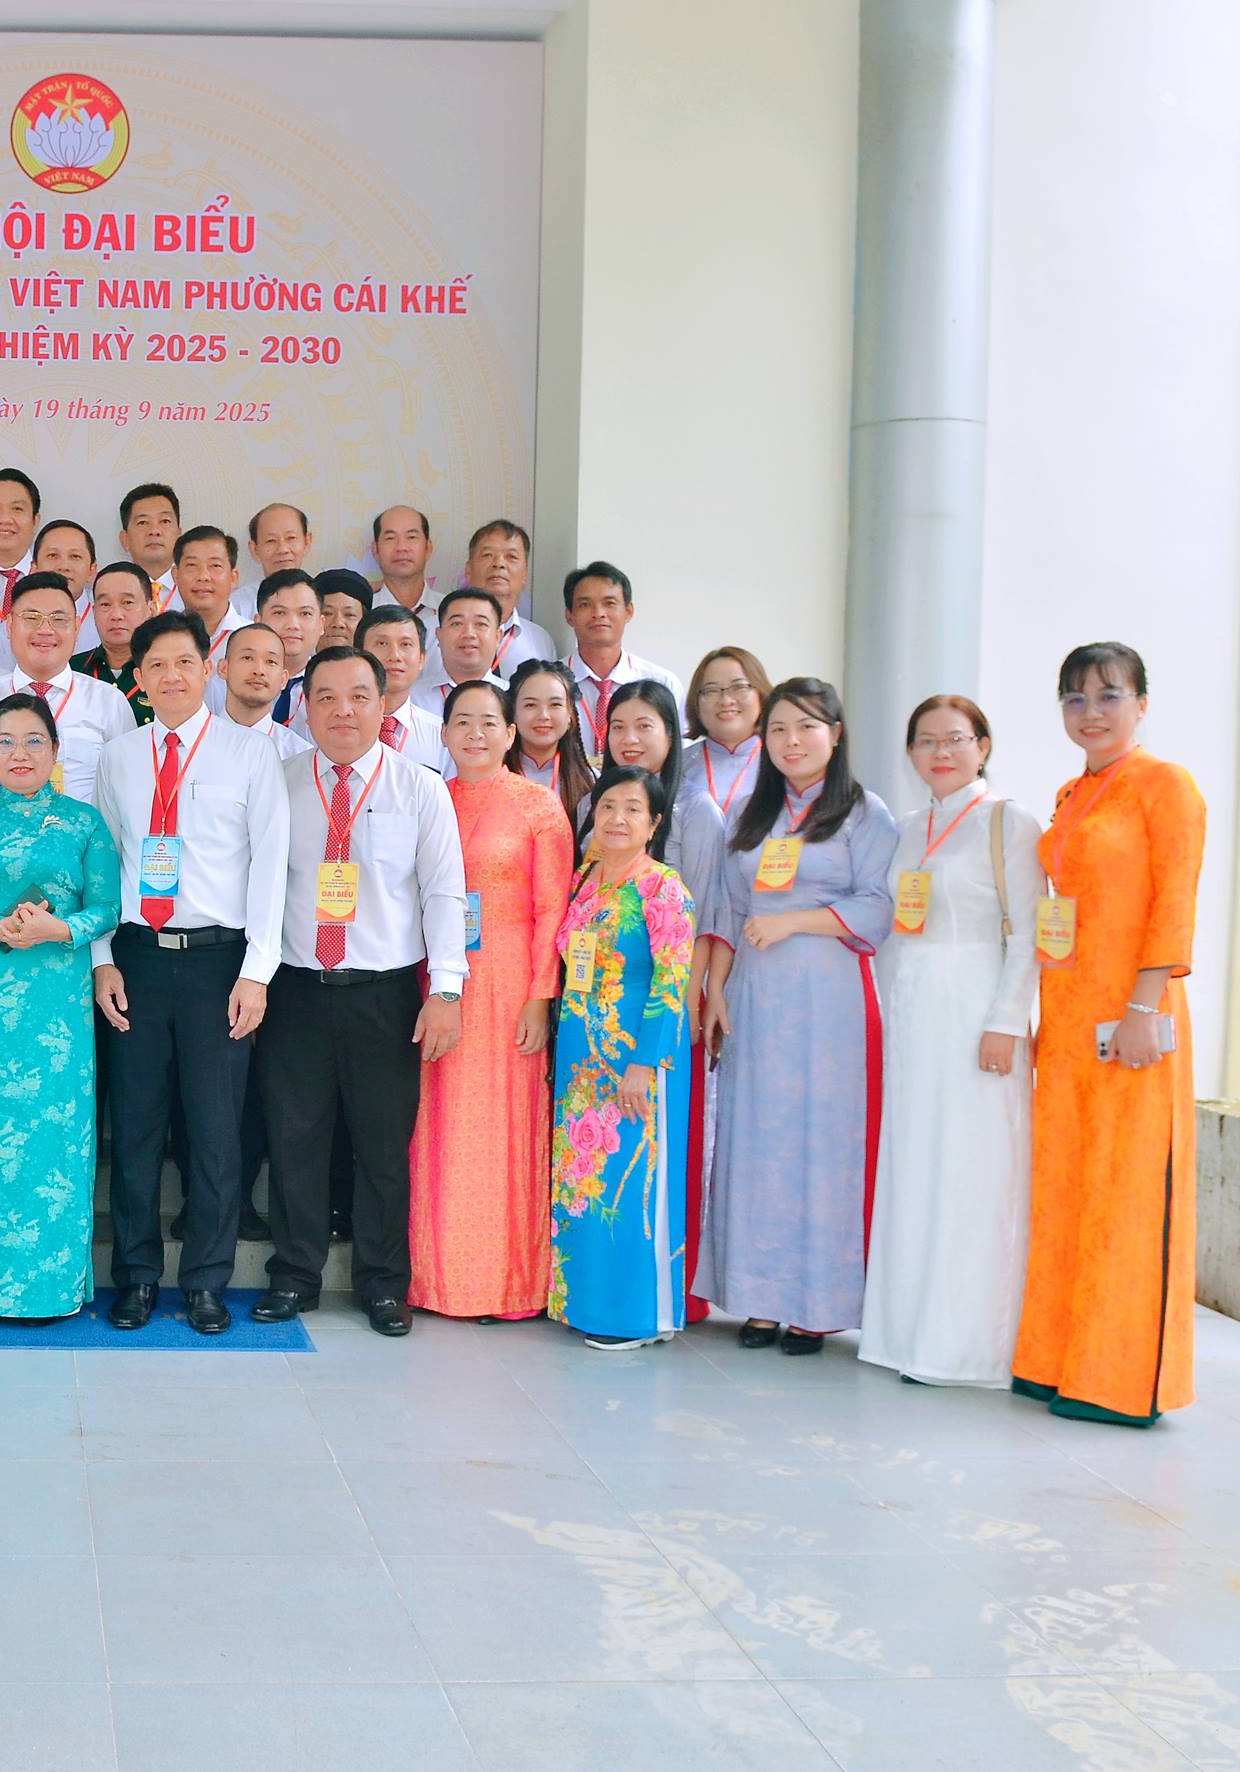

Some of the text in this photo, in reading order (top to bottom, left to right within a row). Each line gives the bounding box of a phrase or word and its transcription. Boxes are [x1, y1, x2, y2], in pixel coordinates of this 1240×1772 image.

[71, 172, 95, 185] NAM
[62, 213, 136, 260] ĐẠI
[154, 194, 256, 254] BIỂU
[9, 270, 85, 315] VIỆT
[98, 279, 172, 310] NAM
[185, 274, 323, 312] PHƯỜNG
[334, 276, 387, 313] CÁI
[401, 274, 473, 315] KHẾ
[92, 326, 135, 361] KỲ
[146, 333, 227, 362] 2025
[261, 336, 342, 365] 2030
[33, 399, 60, 419] 19
[67, 398, 131, 427] tháng
[138, 400, 152, 421] 9
[158, 401, 207, 422] năm
[214, 401, 273, 423] 2025
